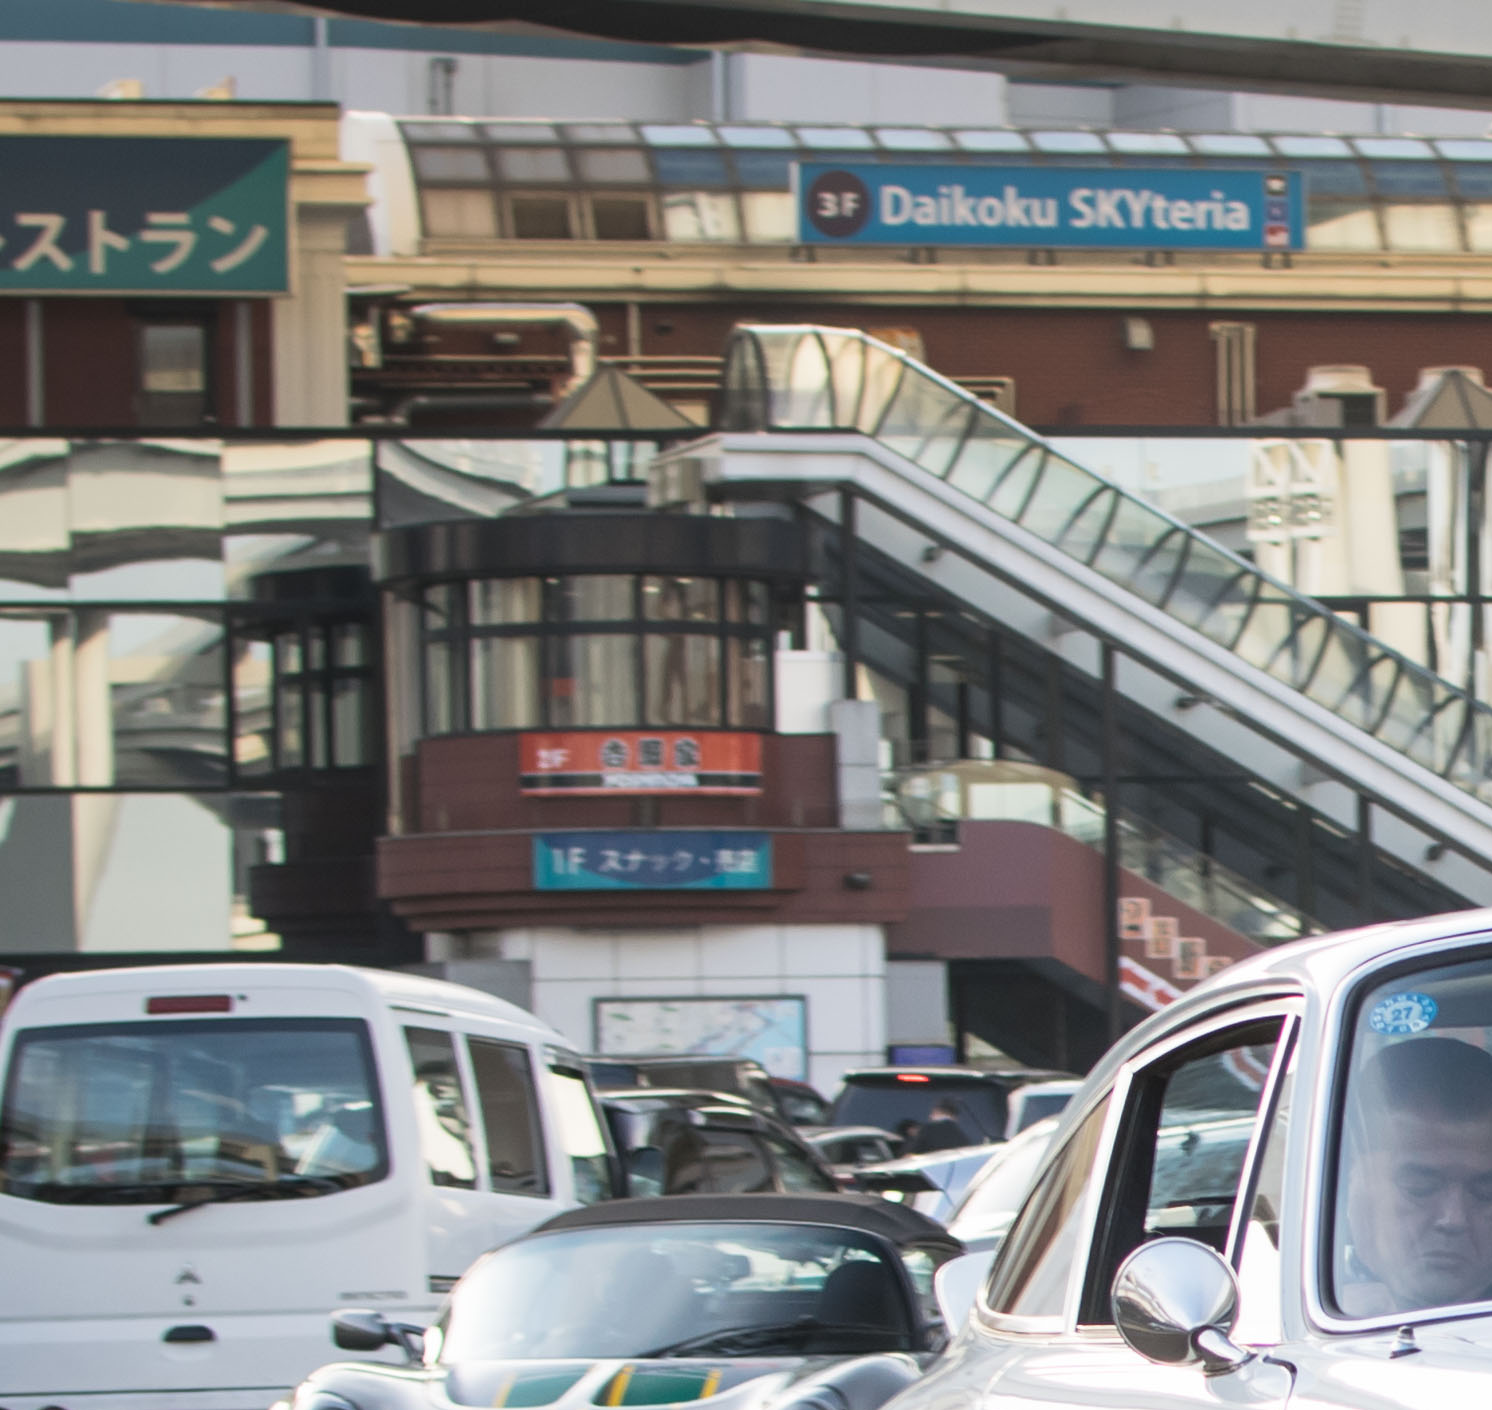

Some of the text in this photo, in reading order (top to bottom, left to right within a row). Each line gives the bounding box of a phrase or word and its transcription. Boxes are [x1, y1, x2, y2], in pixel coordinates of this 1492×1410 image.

[816, 185, 1251, 231] 3F Daikoku SKYteria
[0, 209, 269, 275] ストラン
[552, 847, 584, 874] 1F
